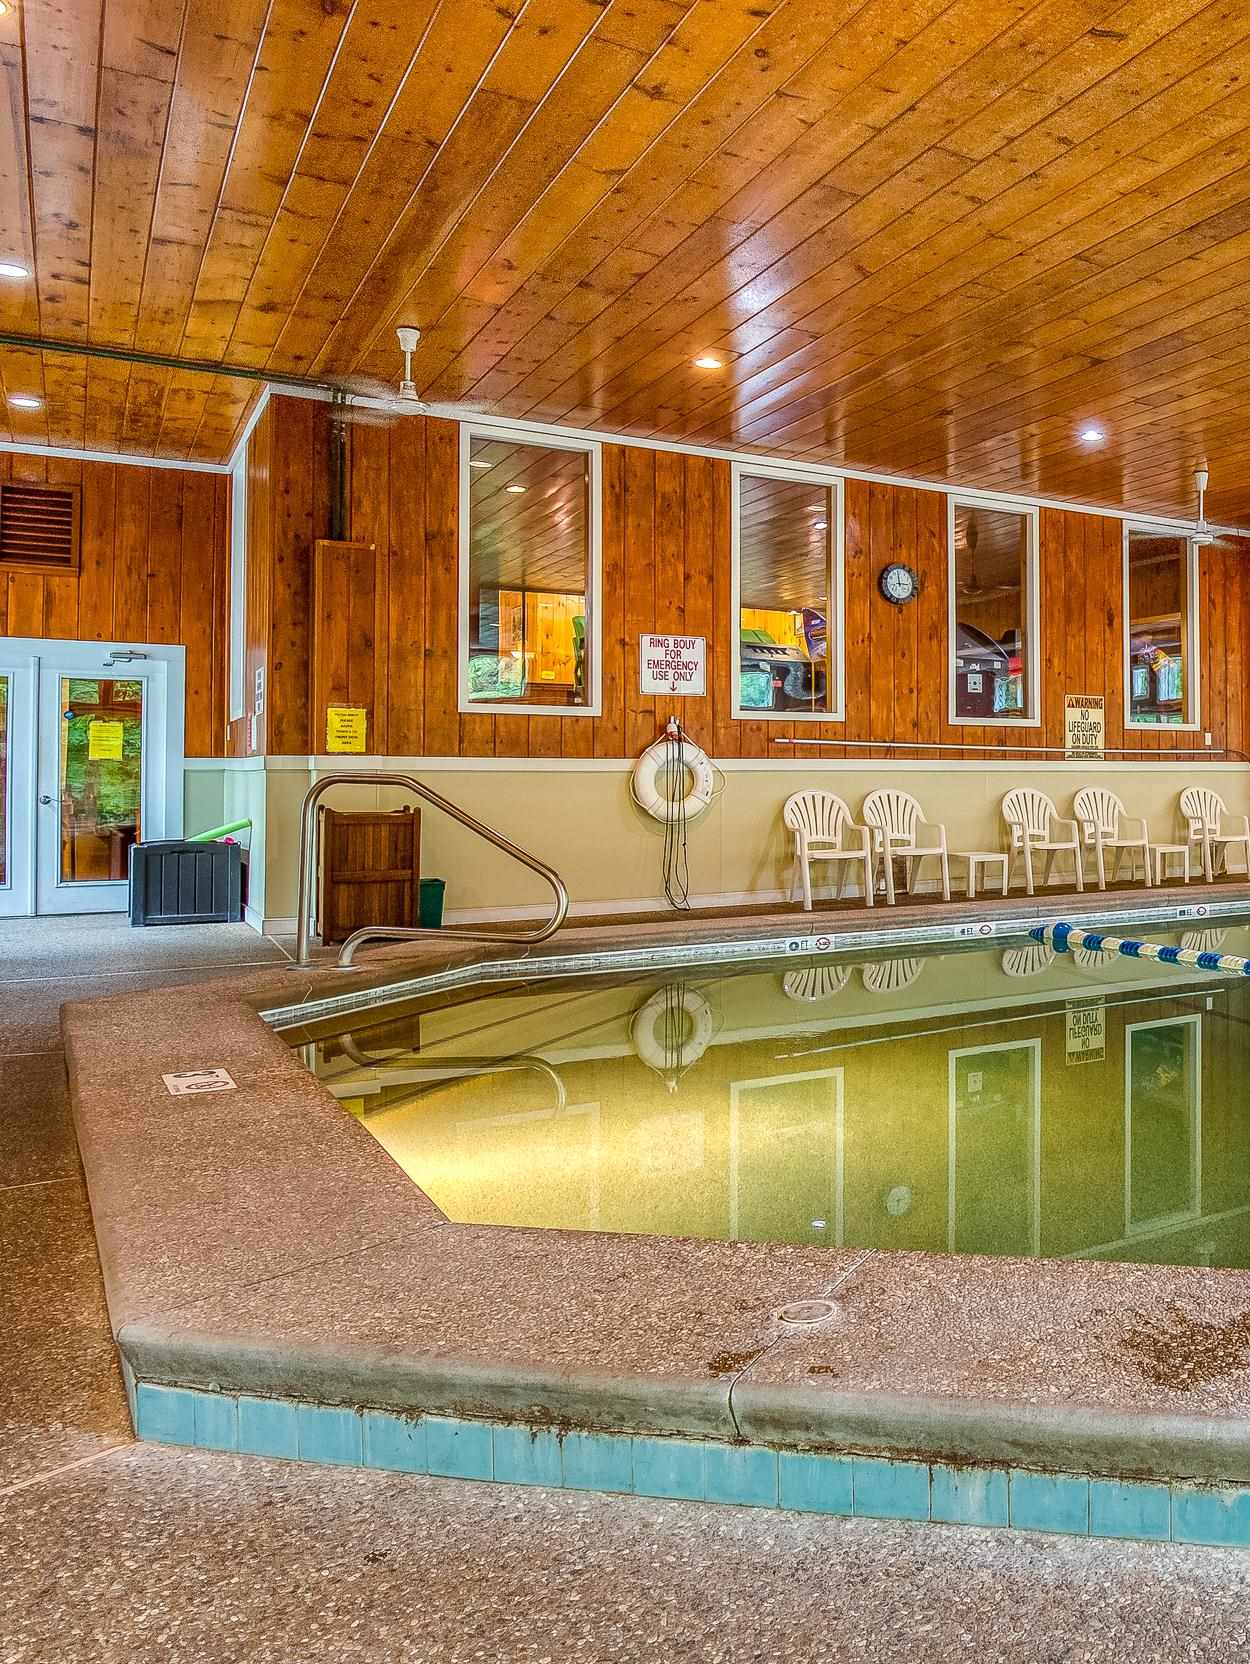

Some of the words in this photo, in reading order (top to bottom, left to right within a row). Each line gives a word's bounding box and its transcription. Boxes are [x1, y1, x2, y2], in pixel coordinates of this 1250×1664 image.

[649, 637, 670, 649] RING
[673, 639, 696, 650] BOUY
[664, 649, 682, 660] FOR
[647, 659, 699, 671] EMERGENCY
[652, 671, 670, 681] USE
[672, 671, 694, 682] ONLY
[1074, 696, 1103, 710] WARNING
[1080, 709, 1090, 721] NO
[1068, 720, 1102, 733] LIFEGUARD
[1071, 732, 1081, 745] ON
[1081, 733, 1098, 745] DUTY
